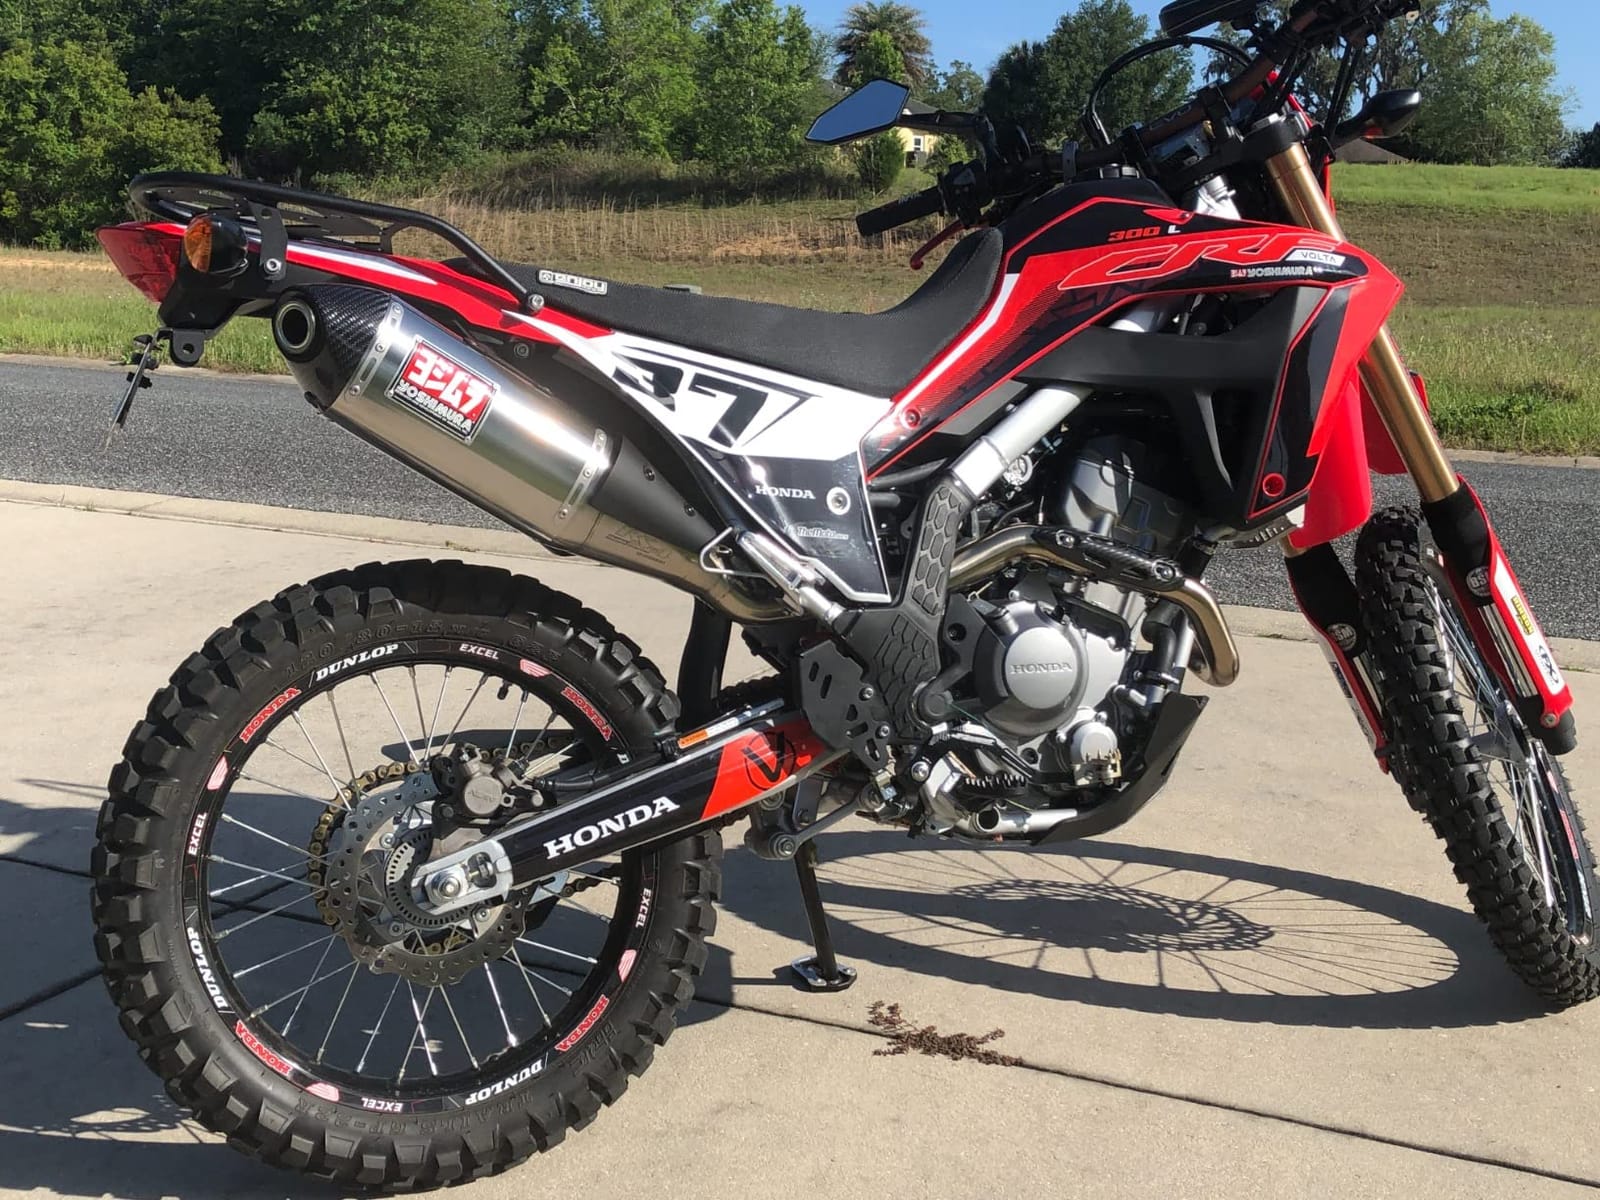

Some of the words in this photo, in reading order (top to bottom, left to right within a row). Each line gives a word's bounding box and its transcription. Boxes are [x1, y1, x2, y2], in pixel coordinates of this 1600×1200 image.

[1107, 226, 1161, 242] 300
[1167, 225, 1181, 234] L
[1057, 233, 1342, 290] CRF
[1247, 266, 1313, 278] YOSHIMURA
[1299, 251, 1337, 263] VOLTA
[395, 379, 473, 433] YOSHIMURA
[611, 351, 769, 448] 37
[754, 484, 816, 500] HONDA
[316, 643, 399, 682] DUNLOP
[459, 643, 500, 660] EXCEL
[1010, 661, 1074, 675] HONDA
[240, 688, 302, 743] HONDA
[561, 686, 614, 741] HONDA
[188, 812, 208, 856] EXCEL
[543, 795, 680, 860] HONDA
[635, 888, 652, 929] EXCEL
[186, 927, 229, 1009] DUNLOP
[554, 994, 610, 1052] HONDA
[235, 1019, 292, 1076] HONDA
[465, 1059, 544, 1105] DUNLOP
[361, 1097, 403, 1113] EXCEL
